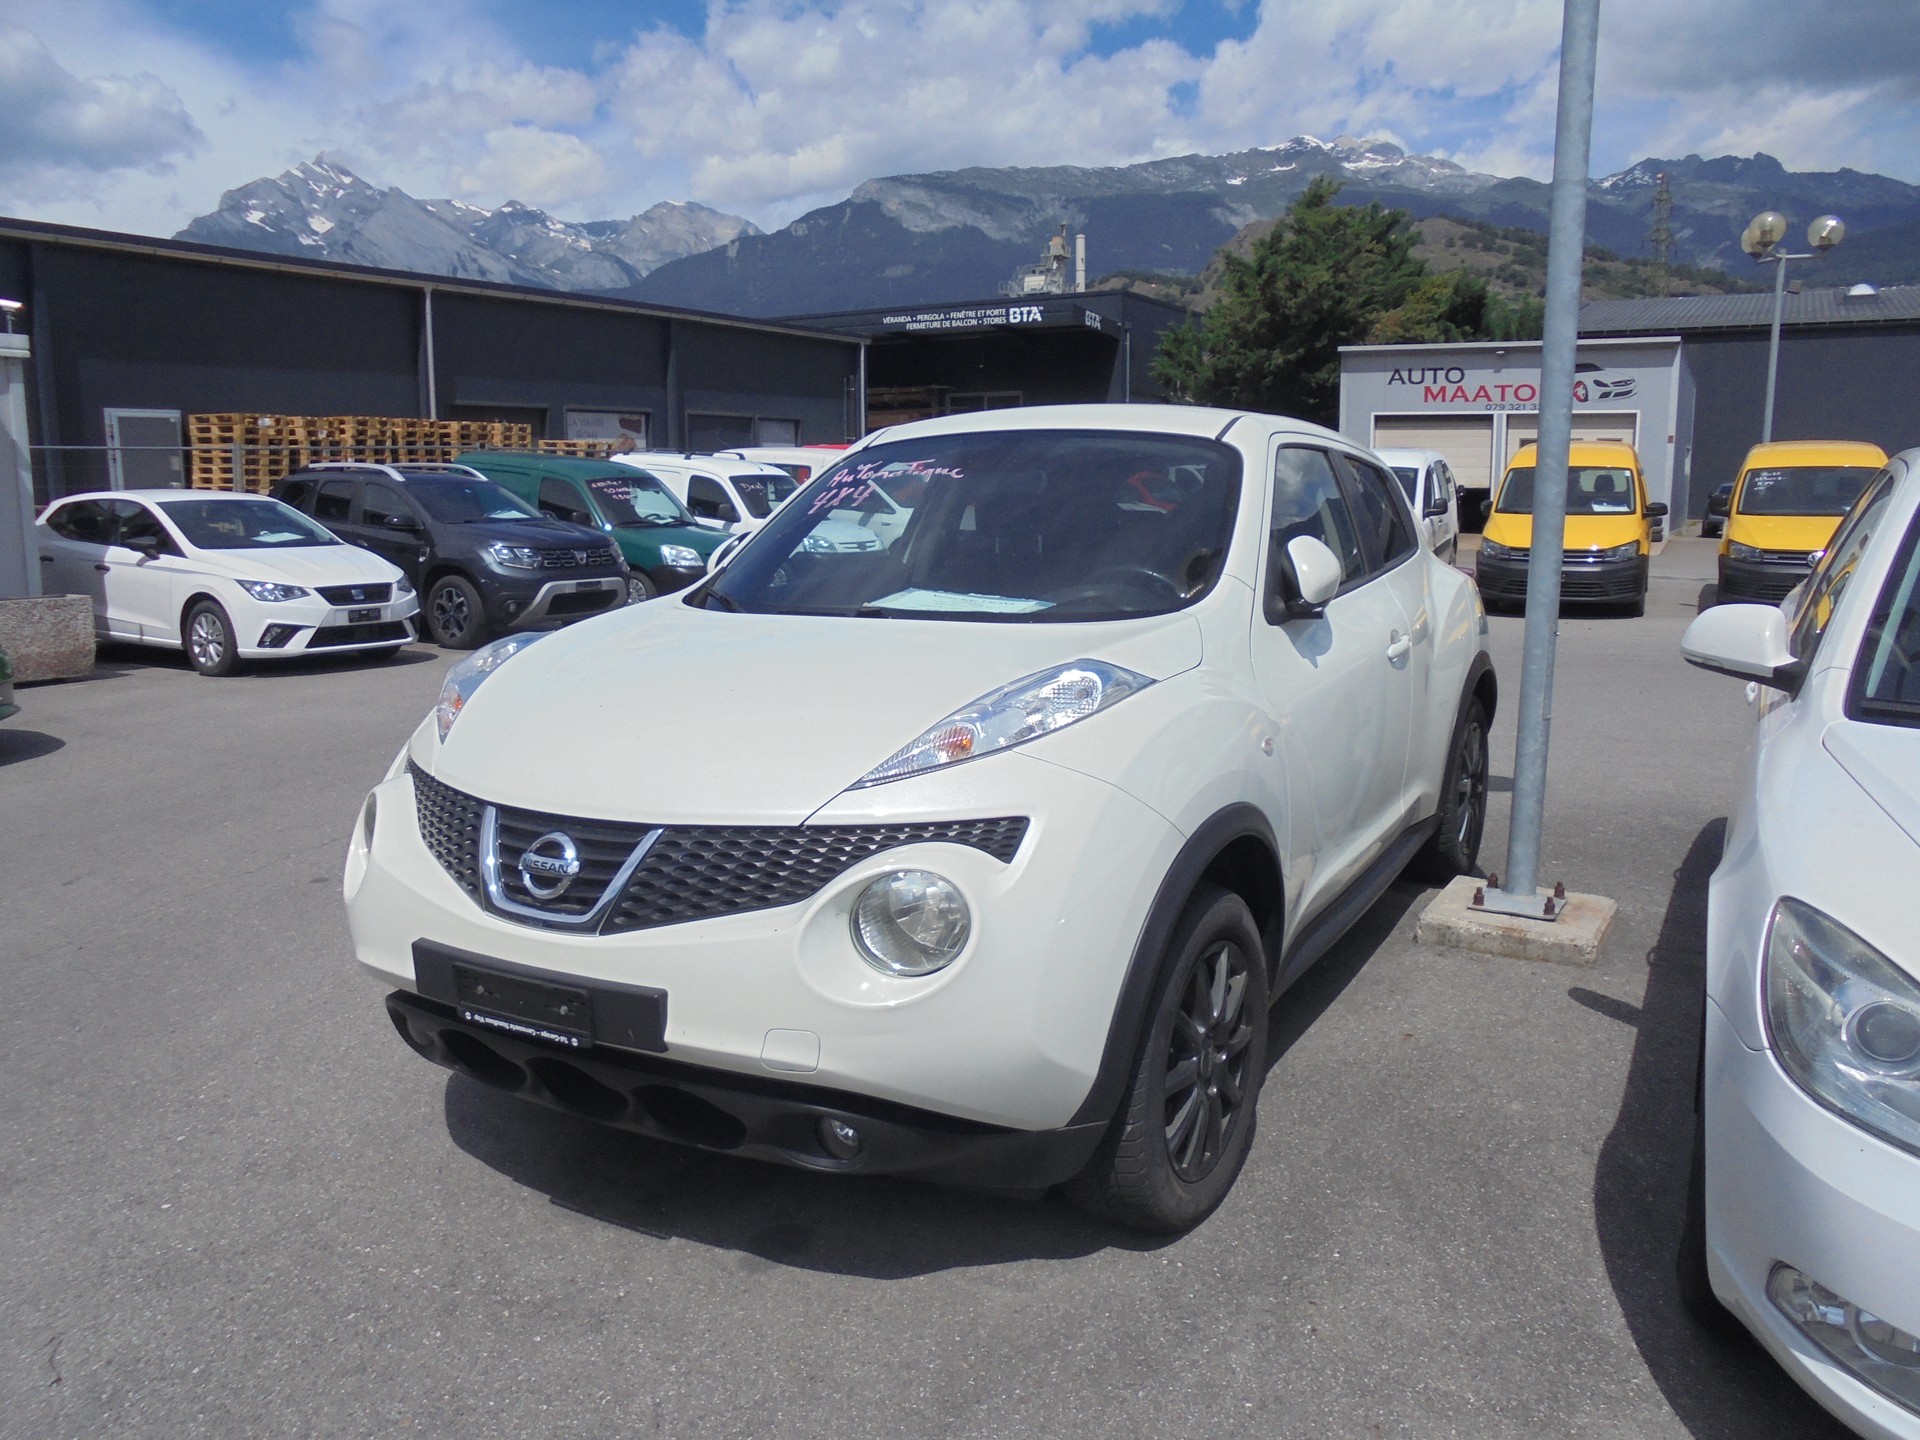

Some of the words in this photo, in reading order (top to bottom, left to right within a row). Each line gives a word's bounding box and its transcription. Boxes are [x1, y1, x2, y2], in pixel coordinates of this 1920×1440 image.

[883, 315, 912, 324] VÉRANDA
[917, 313, 944, 321] PERGOLA
[950, 310, 976, 319] FENÊTRE
[978, 309, 985, 317] ET
[986, 308, 1007, 316] PORTE
[1009, 306, 1042, 323] BTA
[1085, 309, 1102, 330] BTA
[906, 321, 941, 330] FERMETURE
[942, 320, 951, 328] DE
[952, 318, 978, 327] BALCON
[983, 317, 1007, 325] STORES
[1387, 366, 1465, 385] AUTO
[1424, 384, 1540, 403] MAATO
[1485, 403, 1506, 411] 079
[1508, 403, 1526, 411] 321
[523, 857, 570, 875] NISSAN
